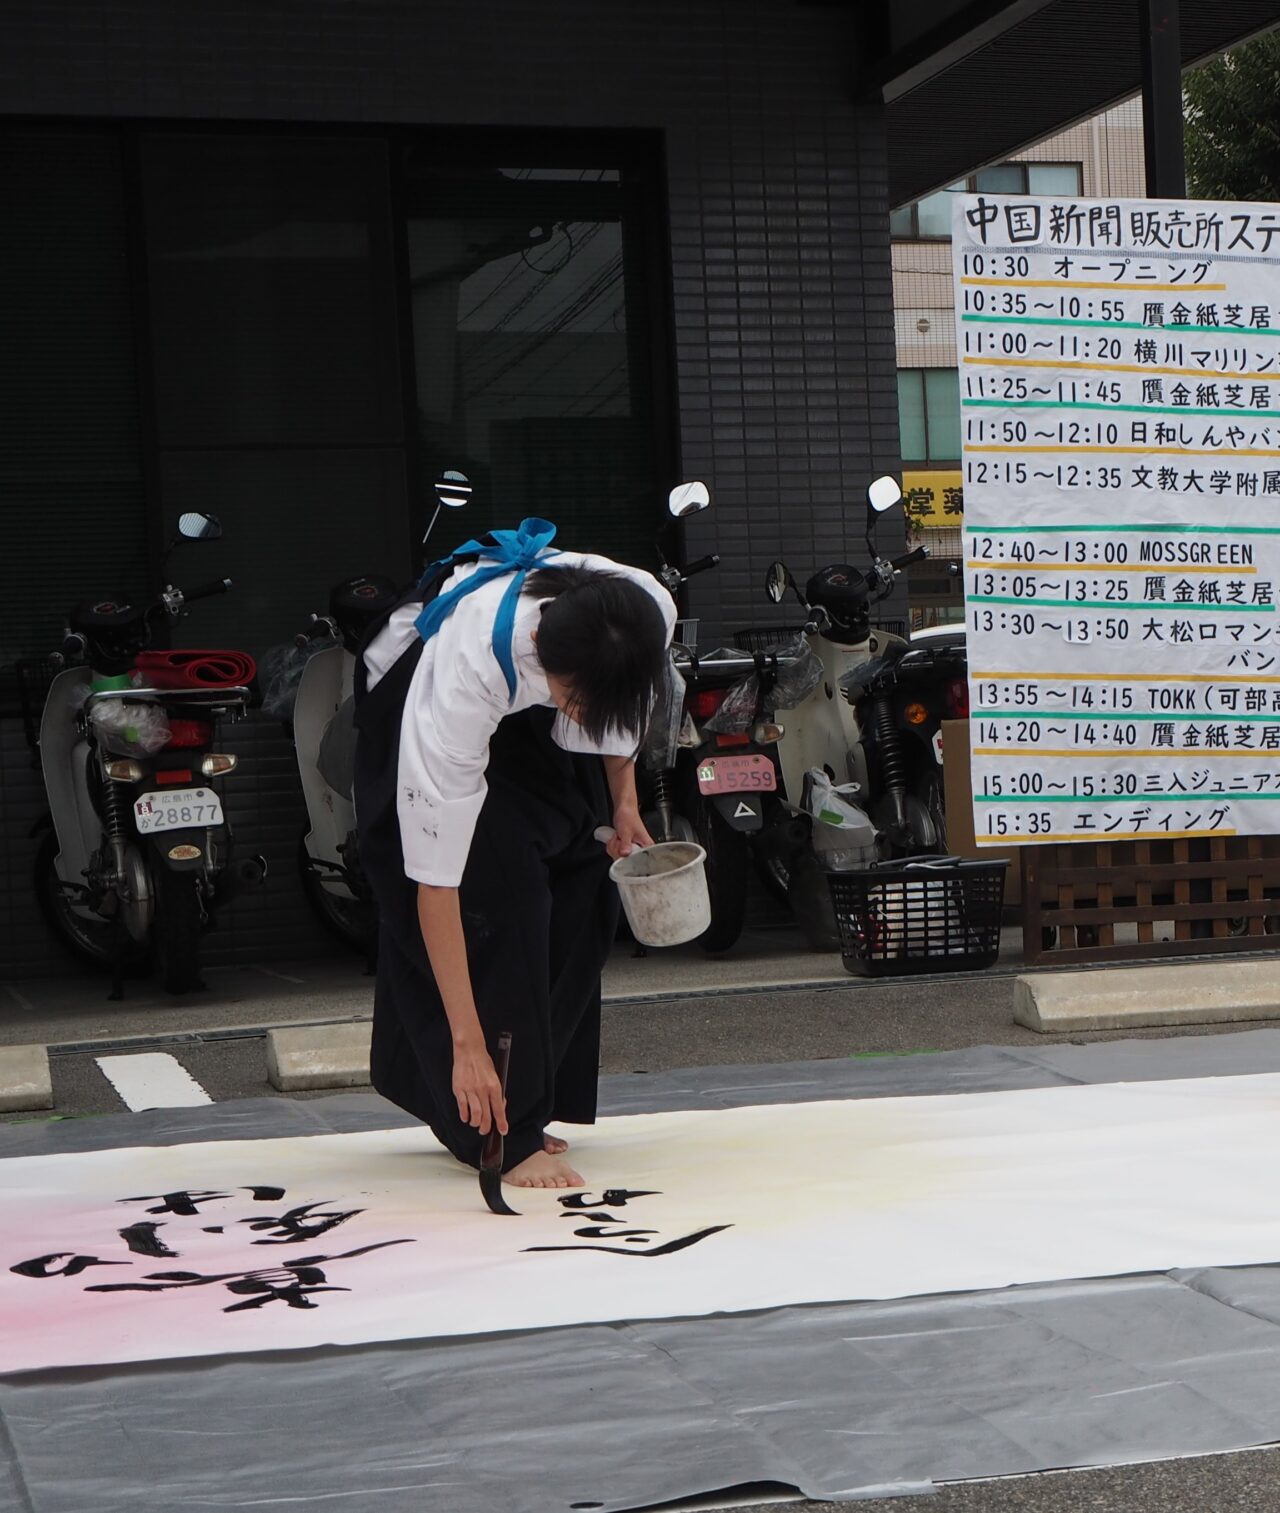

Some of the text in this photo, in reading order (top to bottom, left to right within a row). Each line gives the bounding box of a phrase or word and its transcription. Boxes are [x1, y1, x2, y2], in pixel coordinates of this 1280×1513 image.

[963, 254, 1213, 284] 10:30 オープニング
[1138, 540, 1253, 565] MOSSGREEN
[161, 793, 193, 804] 広島市
[154, 804, 217, 827] 28877
[987, 805, 1231, 835] 15:35 エンディング
